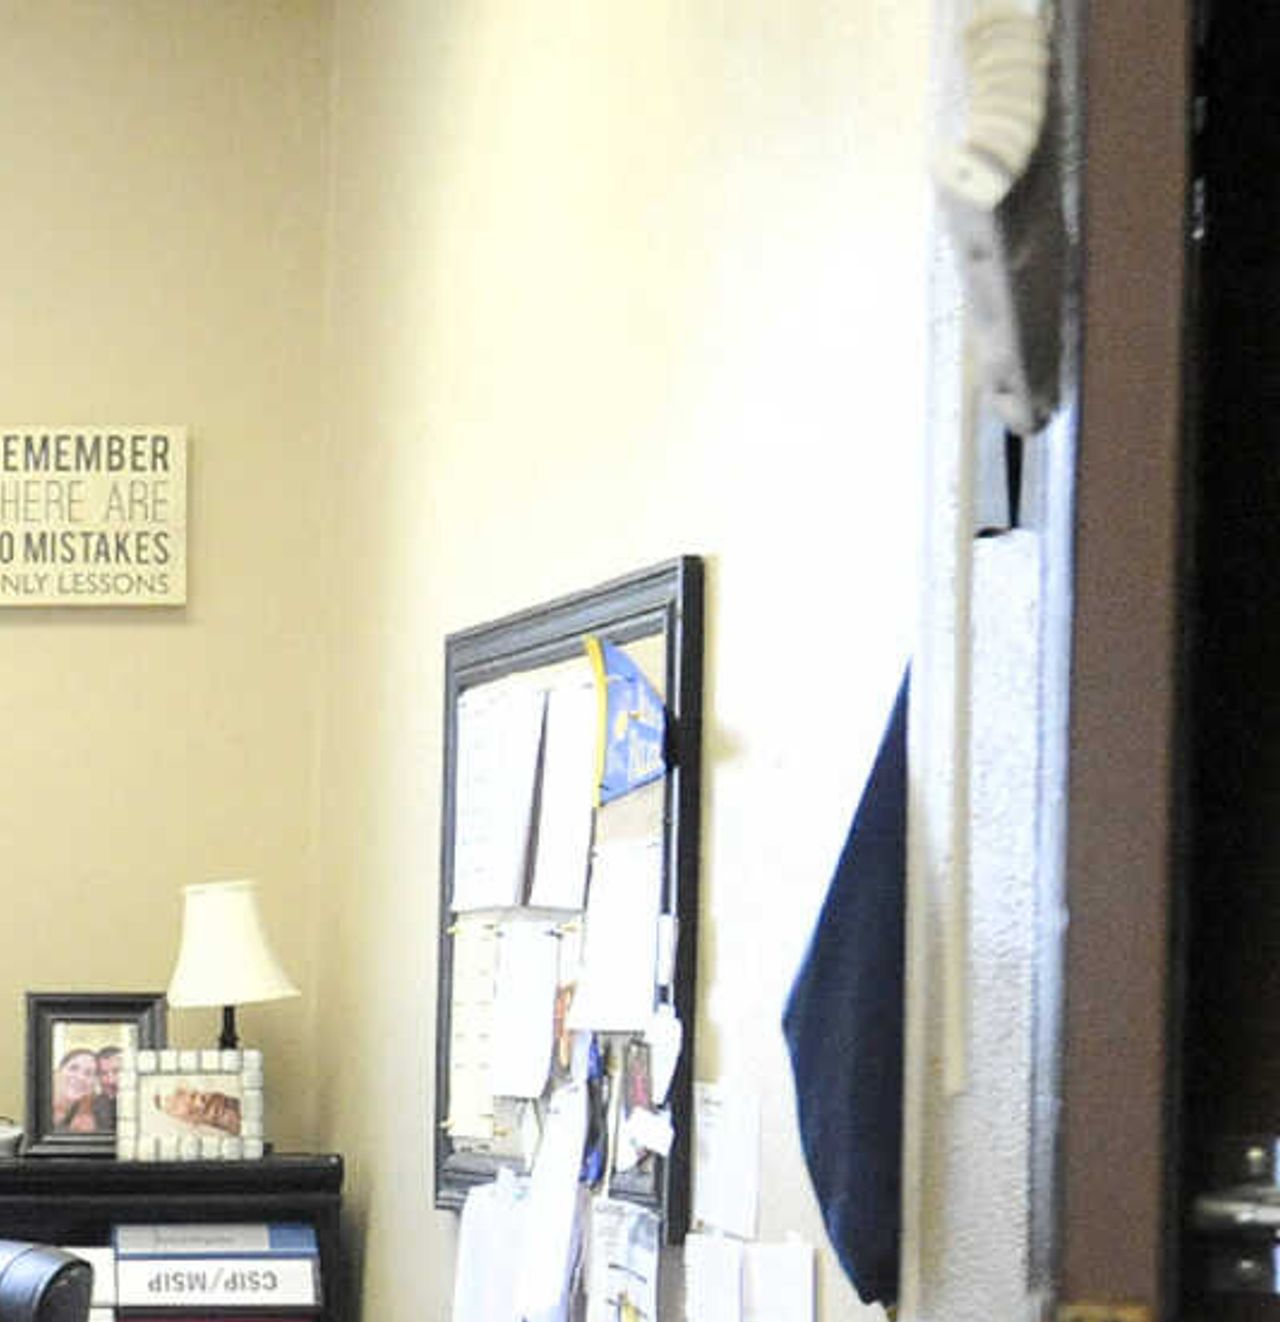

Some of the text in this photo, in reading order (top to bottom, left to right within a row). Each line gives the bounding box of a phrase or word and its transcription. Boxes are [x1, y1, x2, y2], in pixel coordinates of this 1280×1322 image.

[104, 480, 169, 523] ARE
[23, 531, 170, 565] MISTAKES
[57, 573, 170, 595] LESSONS
[147, 1266, 279, 1294] CSIP/MSIP
